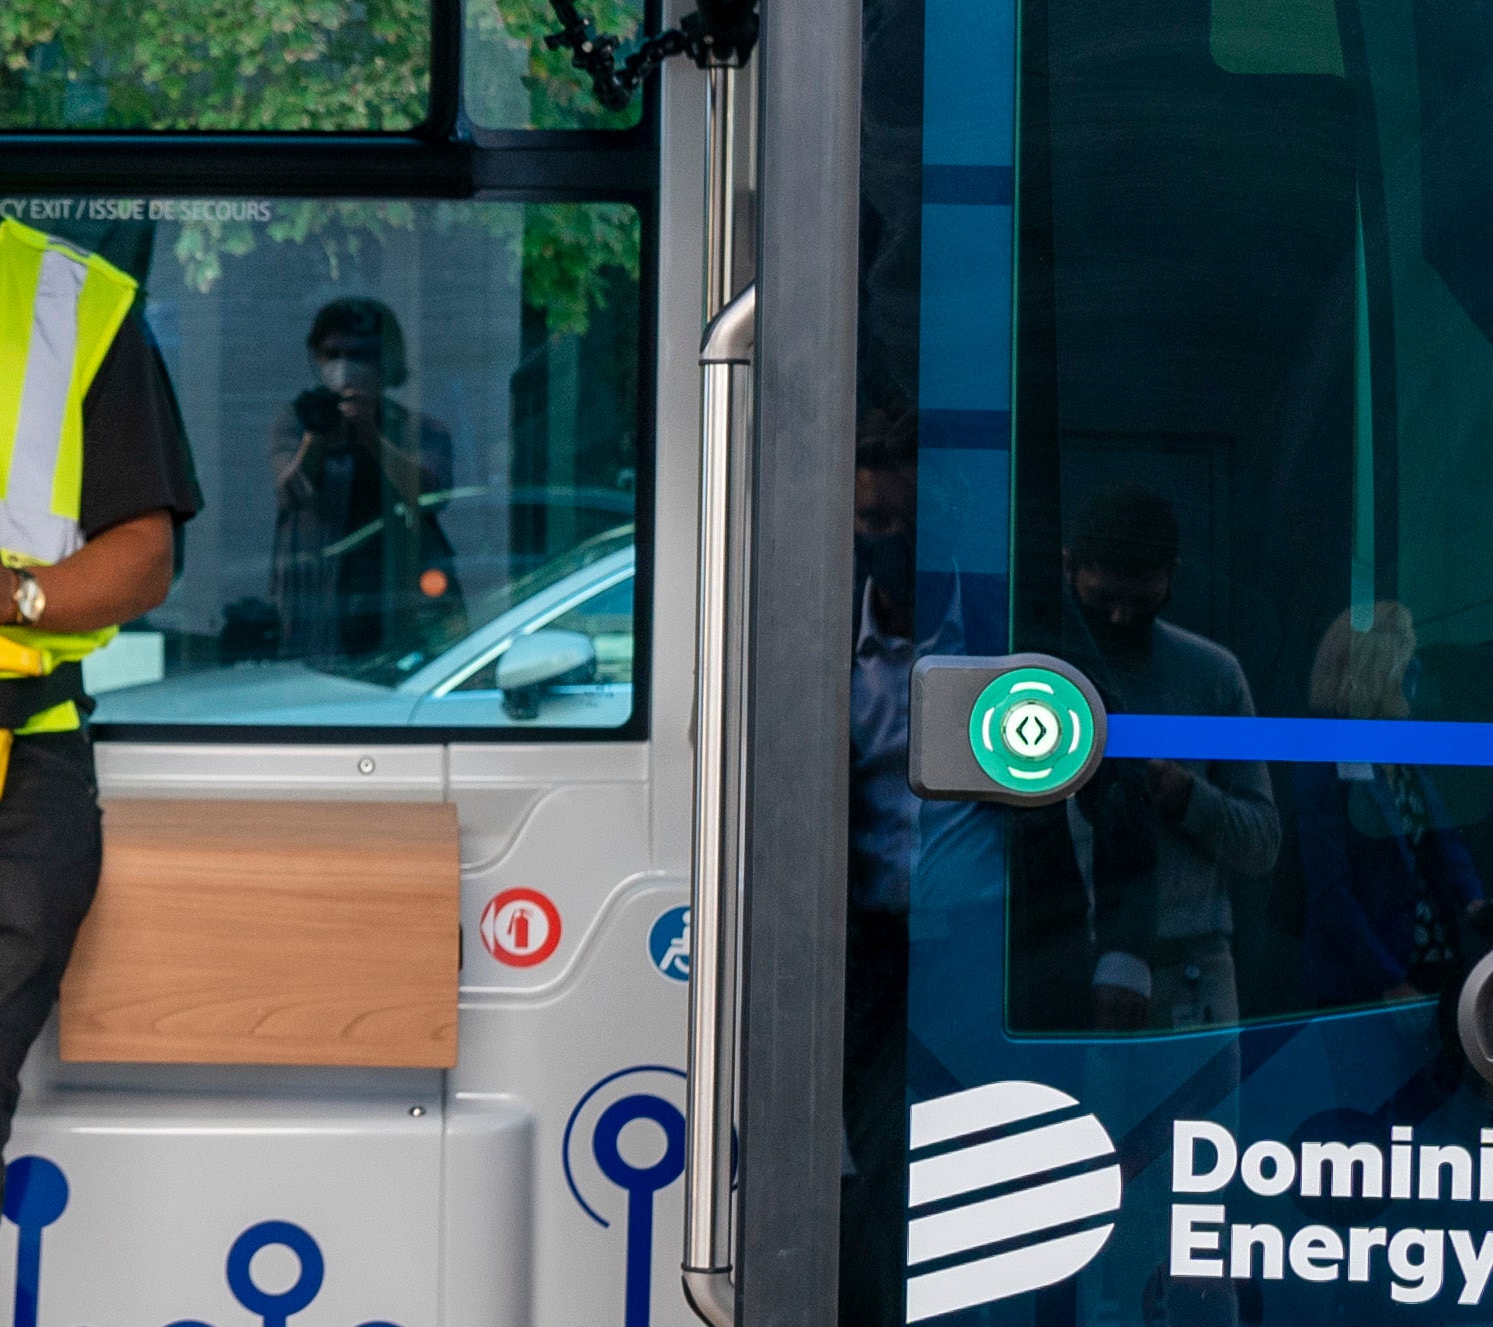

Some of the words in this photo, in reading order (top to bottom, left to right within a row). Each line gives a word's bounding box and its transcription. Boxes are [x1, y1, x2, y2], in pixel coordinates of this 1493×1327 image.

[30, 198, 71, 220] EXIT
[89, 198, 145, 221] ISSUE
[148, 199, 175, 221] DE
[180, 200, 271, 222] SECOURS
